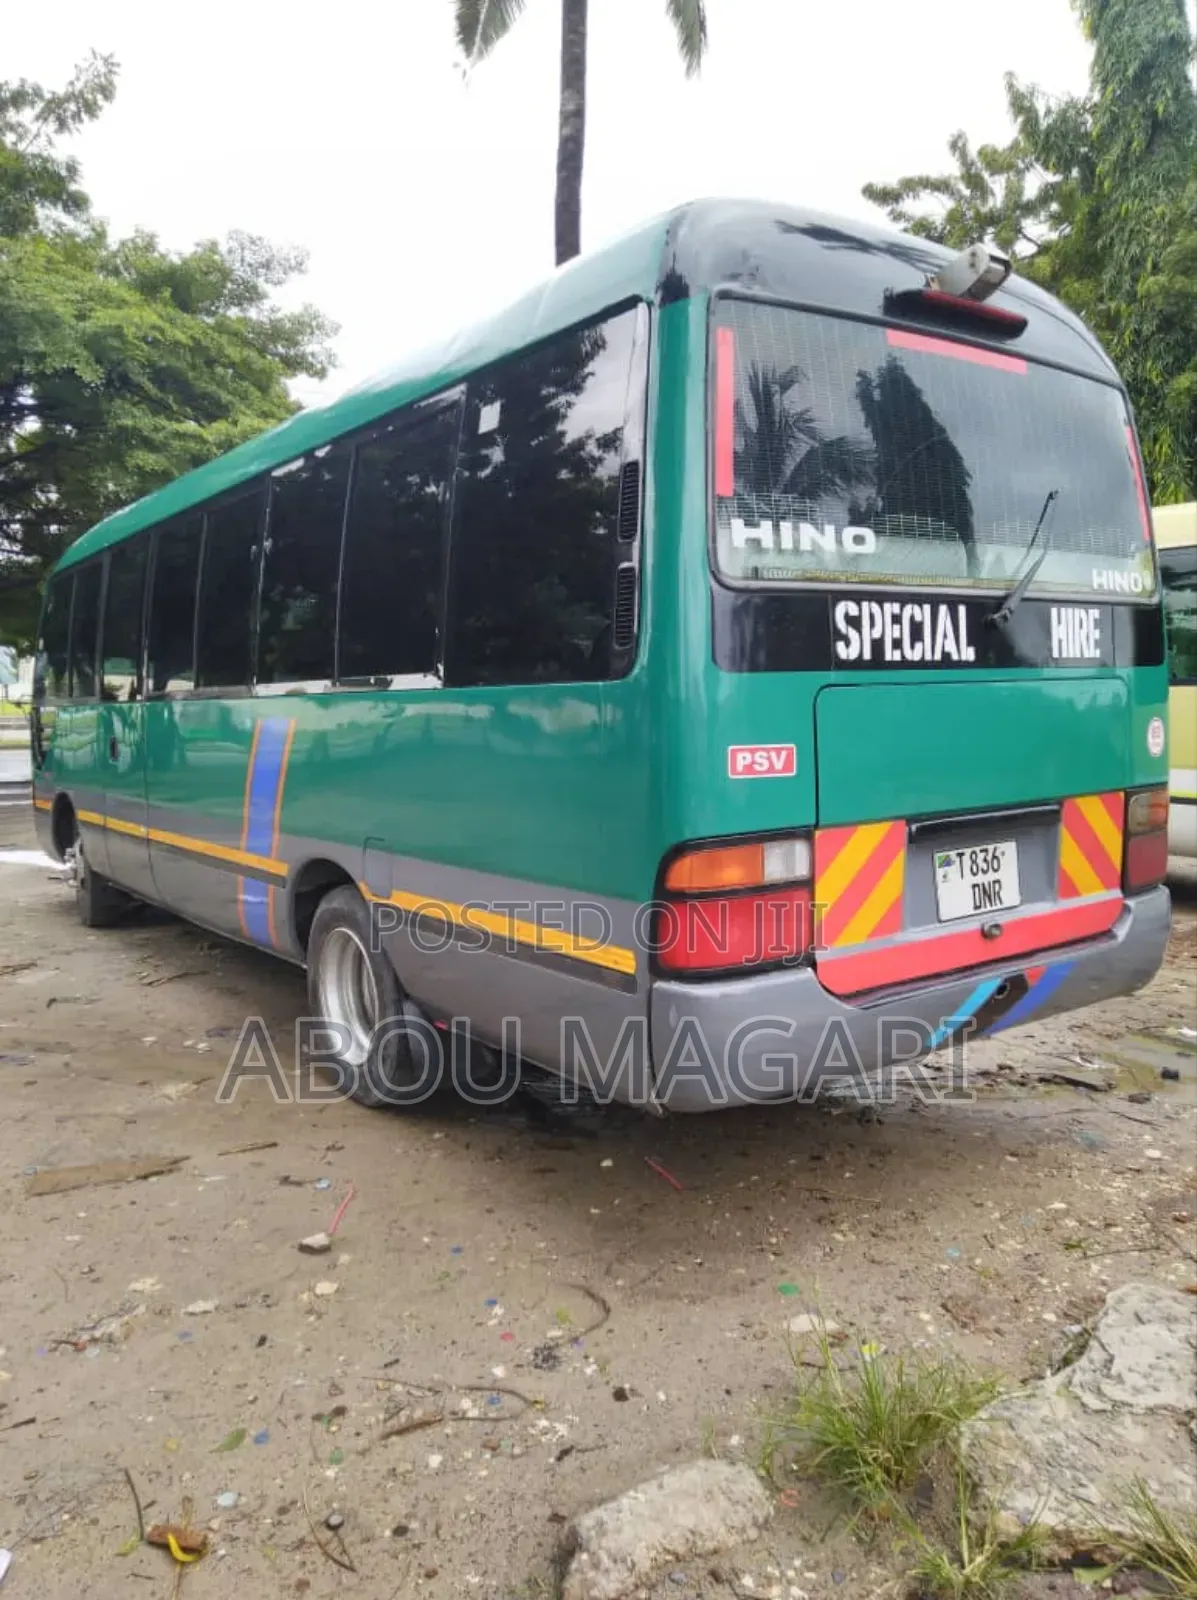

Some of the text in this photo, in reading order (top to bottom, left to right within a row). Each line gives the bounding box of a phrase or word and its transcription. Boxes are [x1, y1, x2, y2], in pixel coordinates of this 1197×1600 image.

[730, 518, 877, 555] HINO
[1091, 567, 1143, 593] HINO
[834, 600, 1101, 663] SPECIAL HIRE
[735, 749, 788, 774] PSV
[956, 846, 1001, 880] T 836
[971, 878, 1003, 911] DNR
